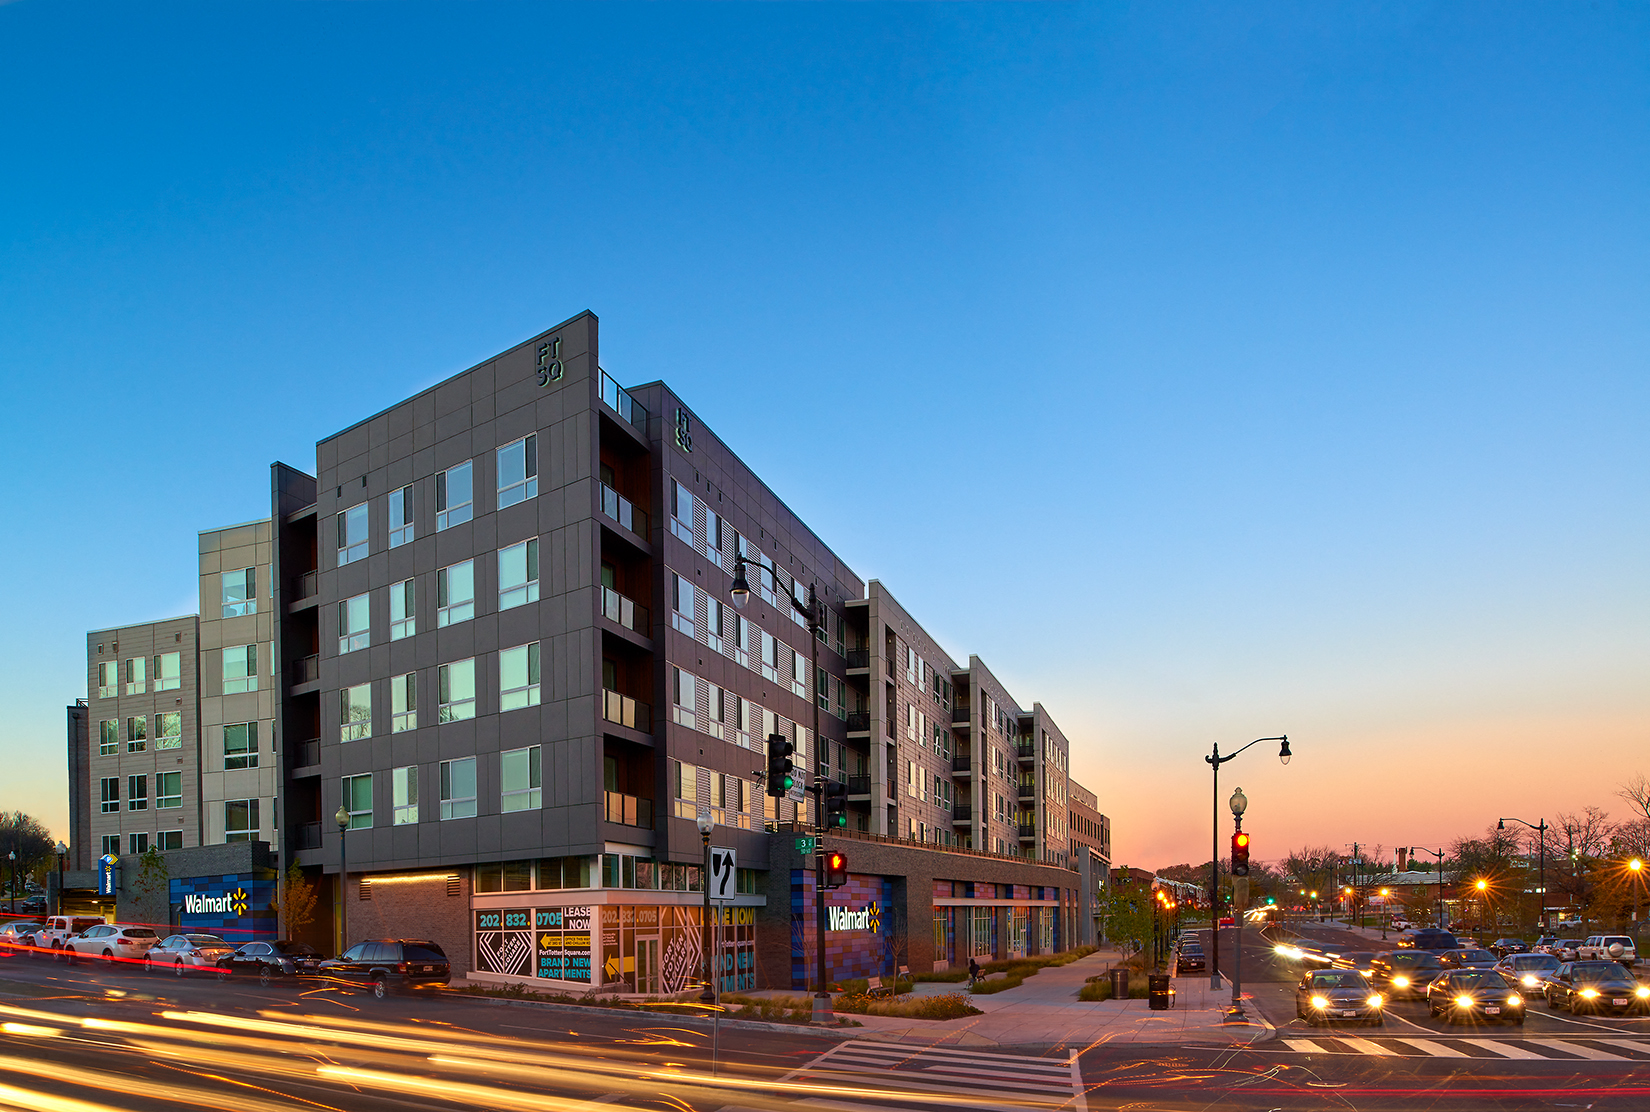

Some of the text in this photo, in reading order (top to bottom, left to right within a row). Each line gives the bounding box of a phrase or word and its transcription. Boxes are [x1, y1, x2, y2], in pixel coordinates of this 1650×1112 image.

[537, 337, 561, 366] FT
[537, 359, 563, 387] SQ
[801, 839, 806, 848] 3
[184, 892, 232, 914] Walmart
[564, 907, 590, 917] LEASE
[536, 912, 562, 926] 0705
[569, 919, 590, 929] NOW
[829, 906, 869, 931] Walmart
[541, 958, 590, 967] BRAND NEW
[538, 968, 591, 979] APARTMENTS
